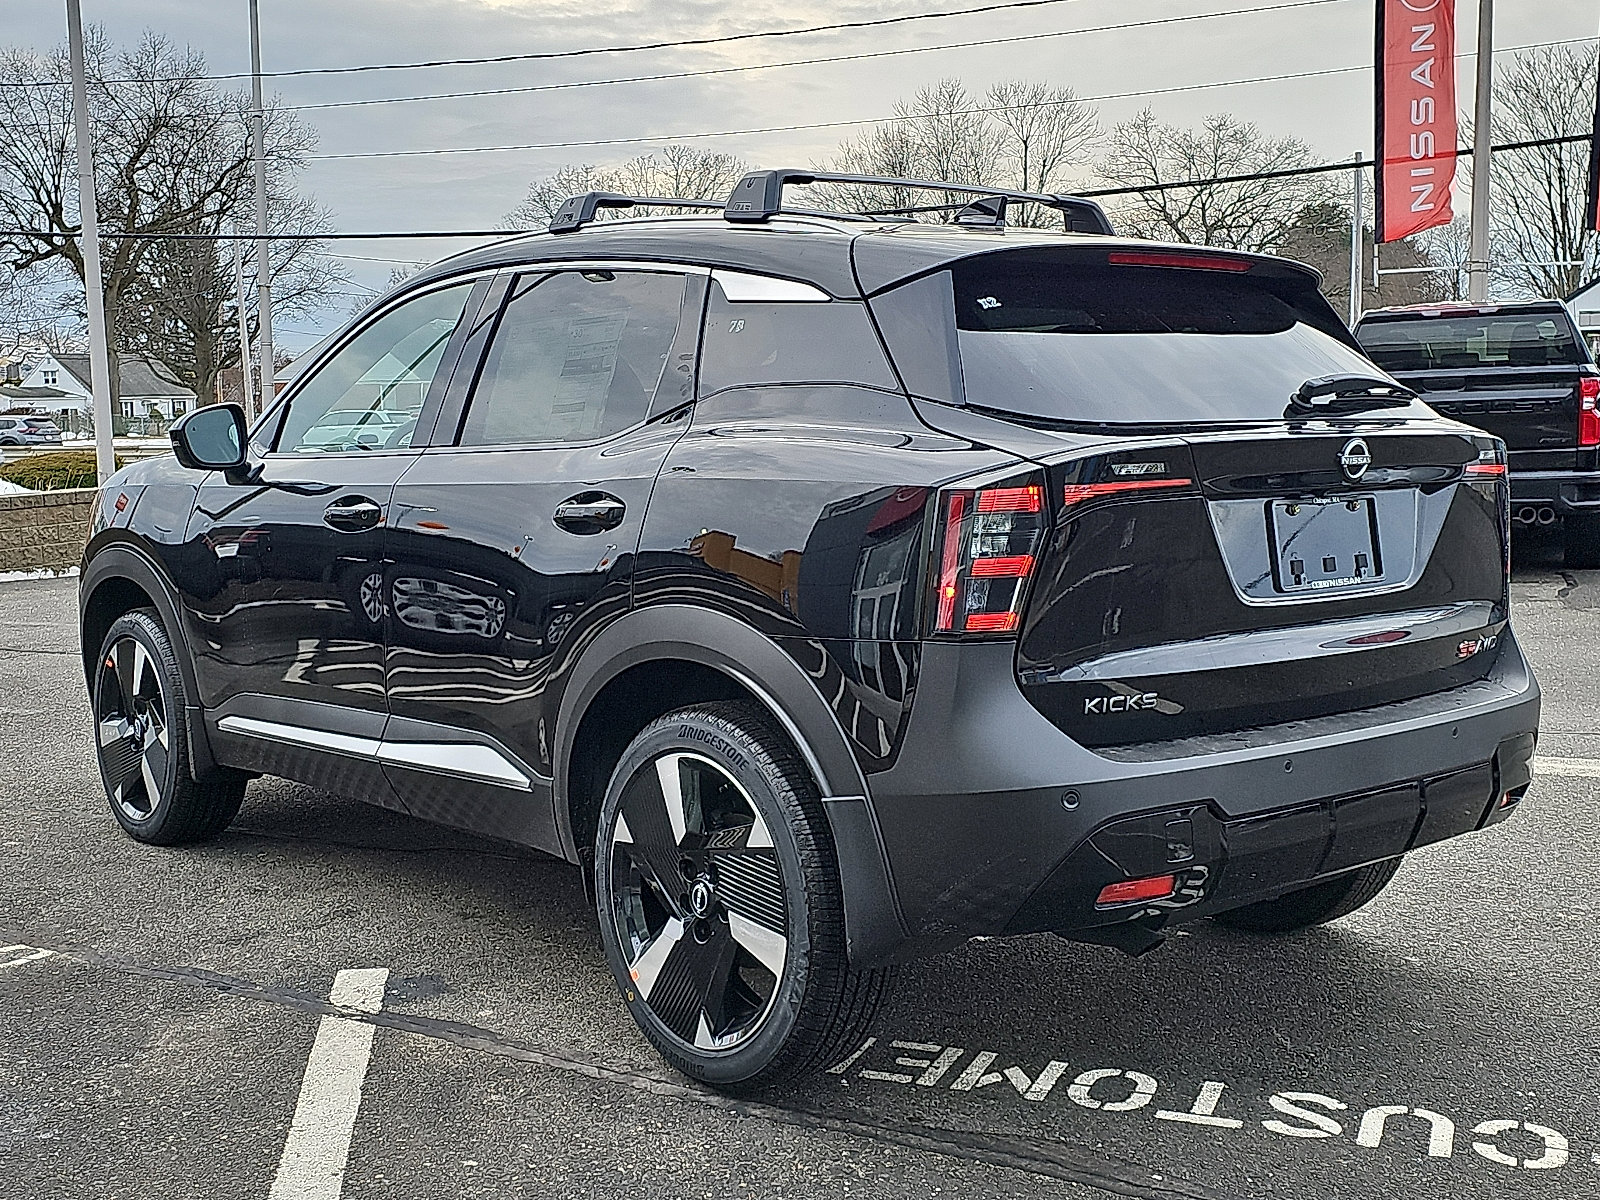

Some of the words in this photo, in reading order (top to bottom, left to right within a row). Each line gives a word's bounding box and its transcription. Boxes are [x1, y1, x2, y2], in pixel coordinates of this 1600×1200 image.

[1410, 23, 1436, 213] NISSAN
[1341, 456, 1371, 465] NISSAN
[1083, 692, 1158, 715] KICKS
[677, 723, 750, 771] BRIDGESTONE
